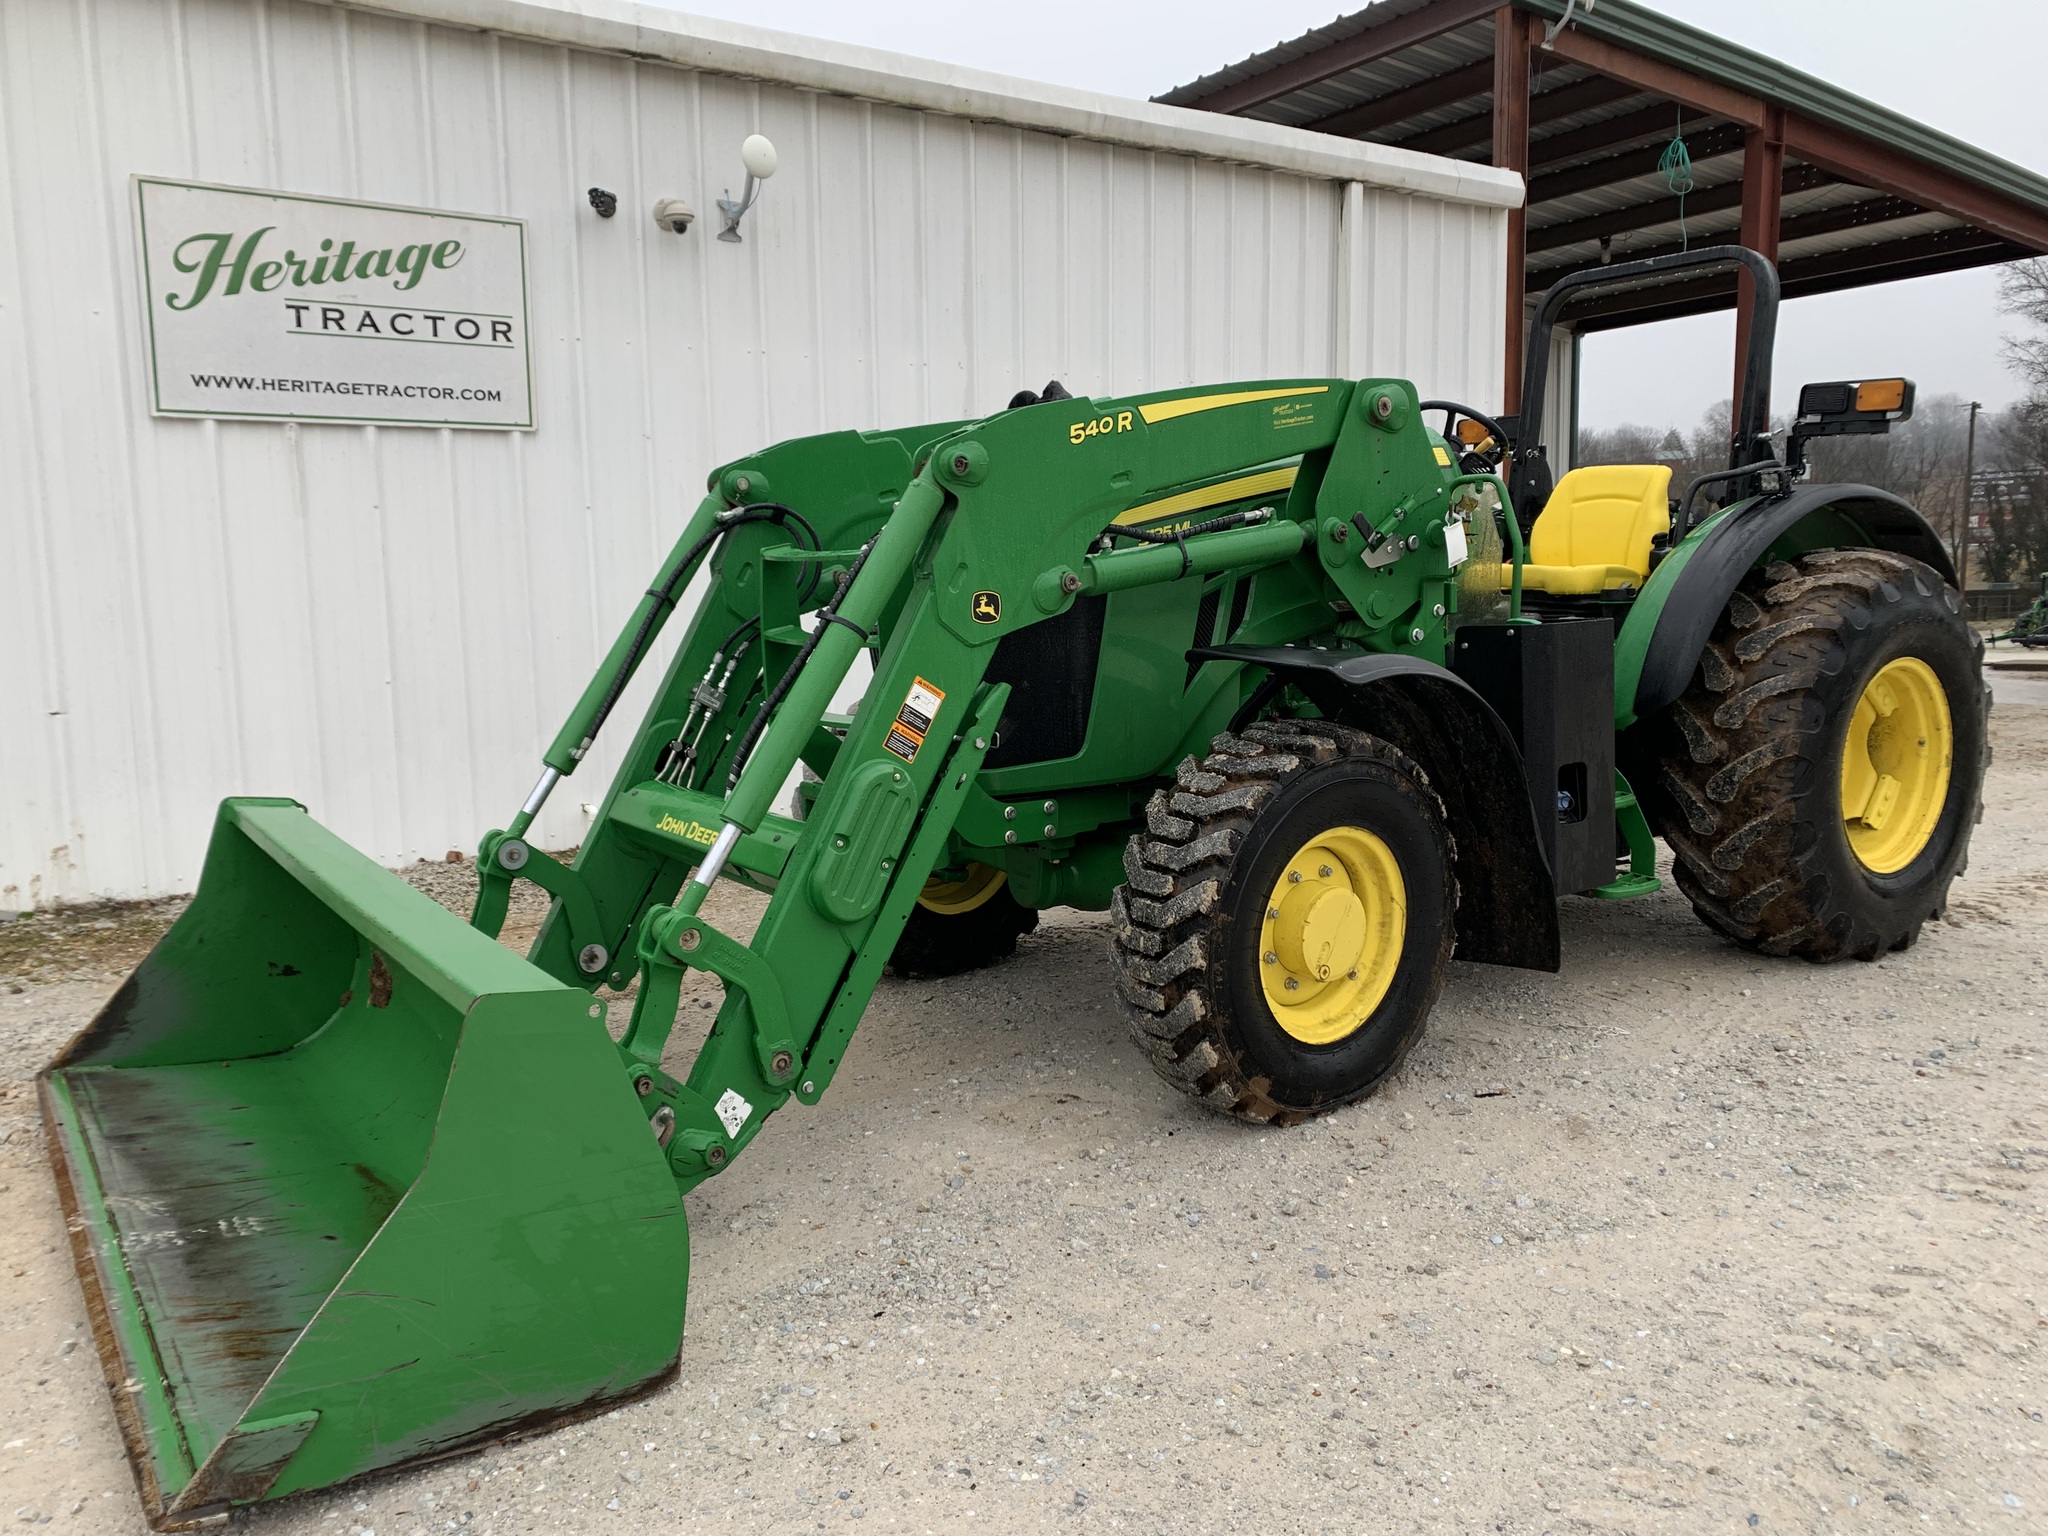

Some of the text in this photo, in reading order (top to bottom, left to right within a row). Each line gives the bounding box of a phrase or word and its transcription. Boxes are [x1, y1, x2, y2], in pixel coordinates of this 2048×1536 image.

[165, 226, 466, 310] Heritage
[285, 304, 513, 343] TRACTOR
[190, 374, 502, 402] WWW.HERITAGETRACTOR.COM
[1070, 411, 1133, 445] 540 R
[656, 813, 720, 845] JOHN DEER
